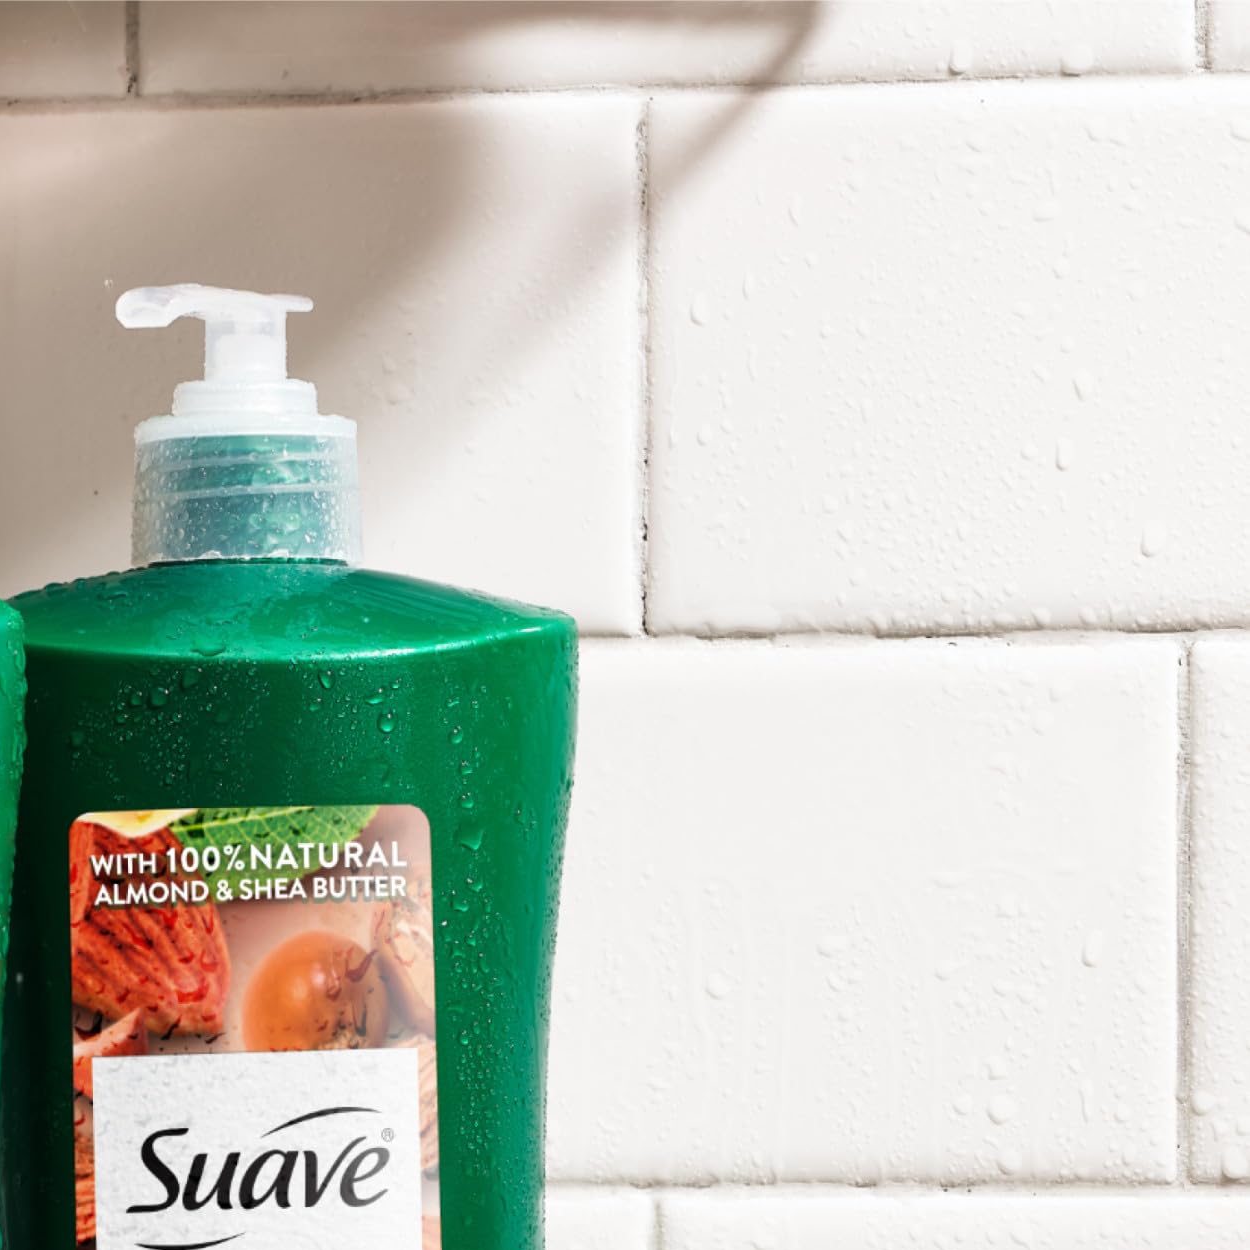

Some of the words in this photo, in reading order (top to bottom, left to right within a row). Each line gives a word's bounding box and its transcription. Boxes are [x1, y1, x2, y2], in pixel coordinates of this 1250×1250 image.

[91, 853, 157, 876] WITH
[94, 880, 209, 906] ALMOND
[216, 880, 233, 900] &
[239, 878, 307, 900] SHEA
[313, 876, 407, 898] BUTTER
